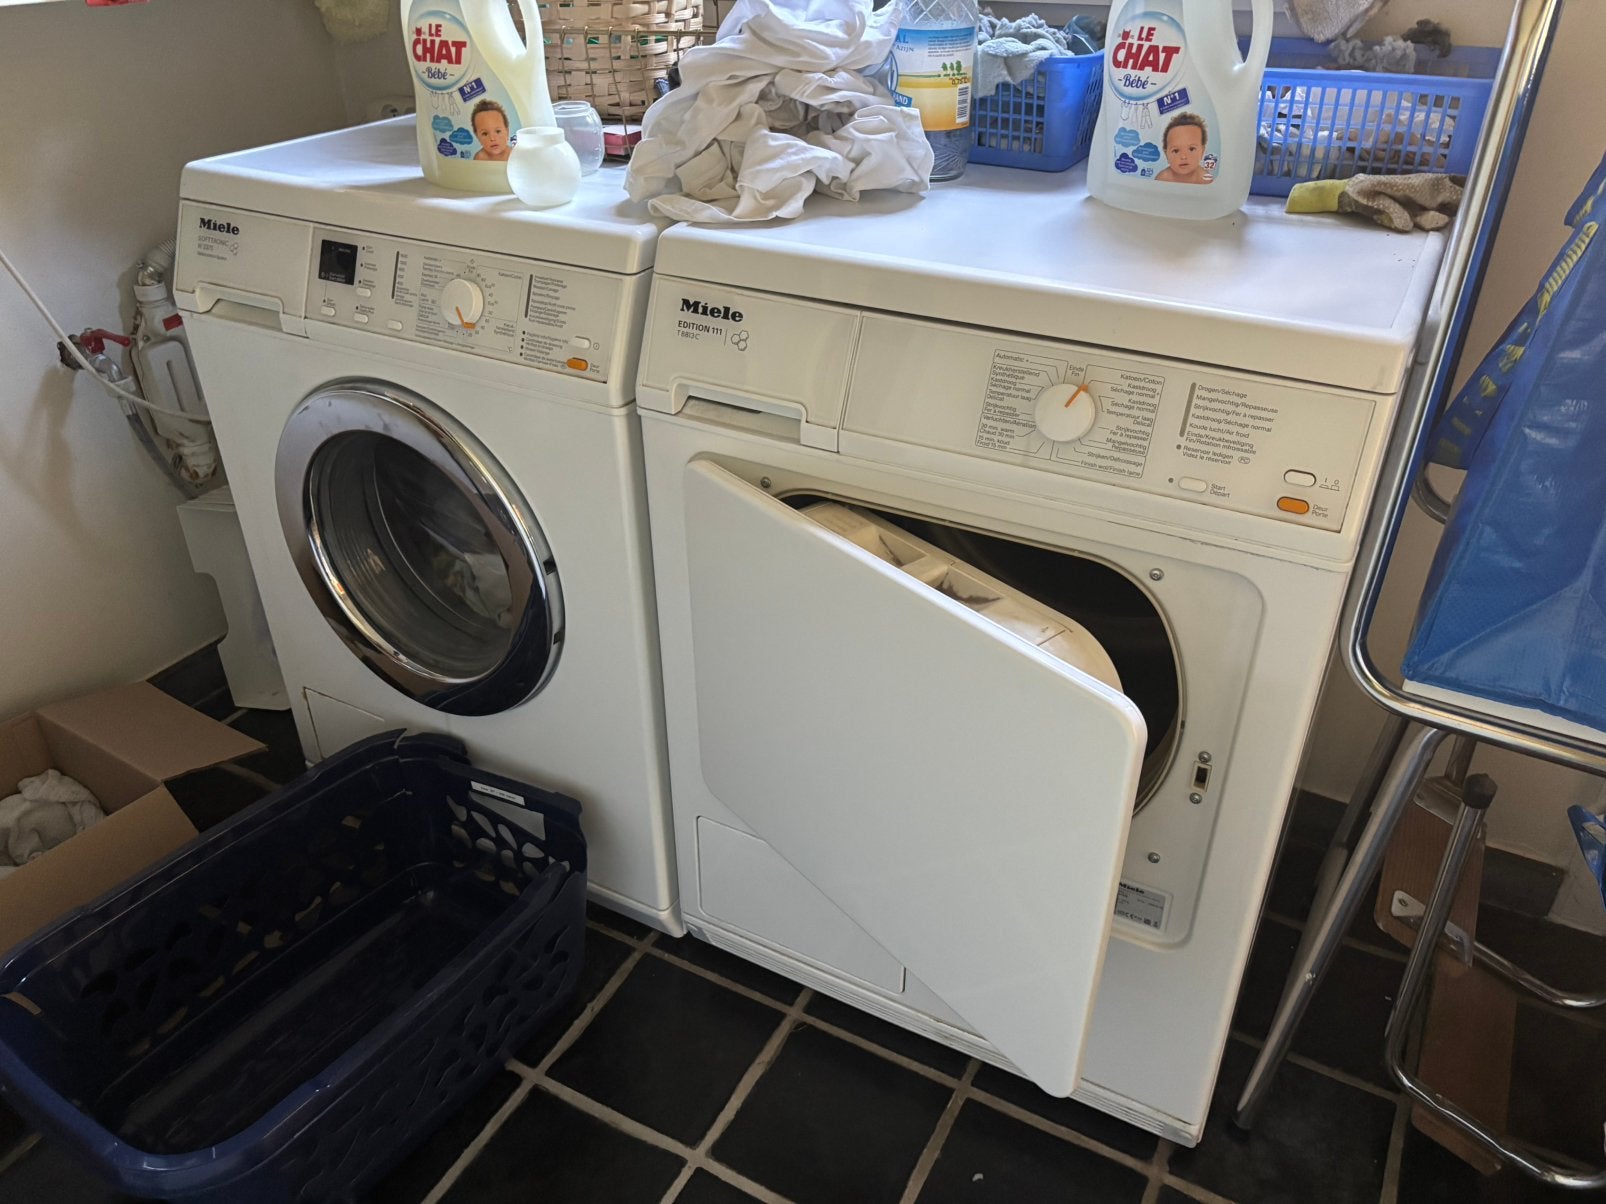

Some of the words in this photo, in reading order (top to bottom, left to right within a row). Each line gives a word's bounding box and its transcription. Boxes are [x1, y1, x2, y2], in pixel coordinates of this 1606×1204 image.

[428, 24, 442, 38] LE
[1137, 26, 1156, 42] LE
[412, 38, 467, 65] CHAT
[1112, 42, 1182, 73] CHAT
[199, 218, 240, 235] Miele
[680, 298, 743, 322] Miele
[678, 320, 710, 333] EDITION
[712, 327, 722, 335] 111
[996, 353, 1024, 362] Automatic
[1120, 374, 1162, 385] Katoen/Coton
[1198, 384, 1247, 399] Drogen/Séchage
[1196, 394, 1278, 413] Mangelvochtig/Repasseuse
[1192, 413, 1249, 429] Kastdroog/Séchage
[1251, 424, 1272, 432] normal
[1248, 414, 1275, 423] repasser
[1185, 437, 1221, 448] Fin/Rotation
[1312, 510, 1328, 518] Porte
[1313, 504, 1328, 512] Deur
